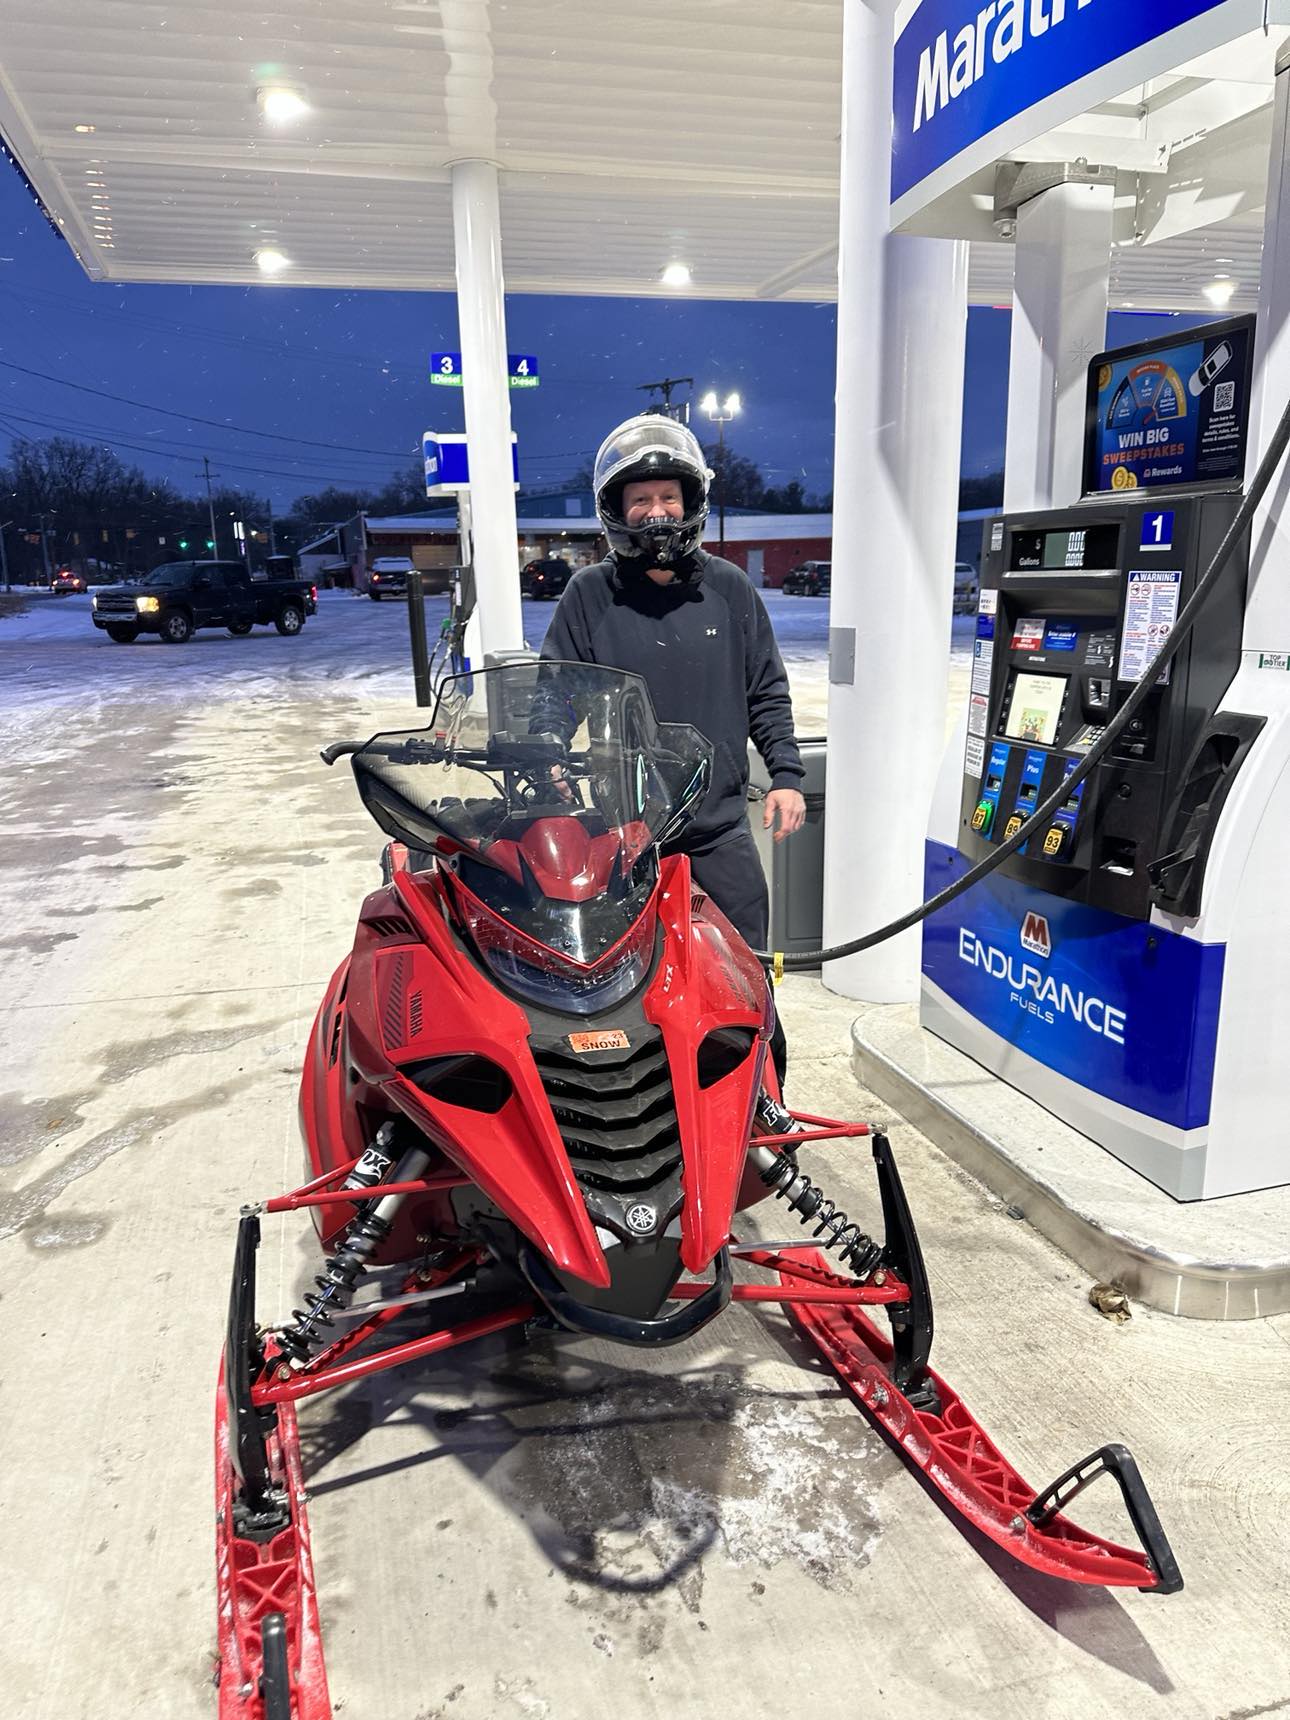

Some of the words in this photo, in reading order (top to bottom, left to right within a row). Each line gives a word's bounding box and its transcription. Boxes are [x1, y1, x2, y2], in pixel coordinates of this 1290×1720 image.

[440, 356, 454, 374] 3
[517, 359, 529, 376] 4
[434, 375, 461, 385] Diesel
[511, 376, 537, 386] Diesel
[1118, 431, 1144, 449] WIN
[1146, 427, 1169, 445] BIG
[1102, 443, 1185, 465] SWEEPSTAKES
[1151, 465, 1182, 477] Rewards
[1152, 514, 1163, 542] 1
[1018, 557, 1040, 566] Gallons
[1140, 573, 1176, 583] WARNING
[1026, 764, 1040, 774] Plus
[973, 812, 985, 824] 87
[1006, 823, 1019, 836] 89
[1046, 835, 1060, 849] 93
[663, 964, 674, 993] LTX
[959, 927, 1127, 1045] ENDURANCE
[409, 989, 423, 1039] YAMAHA
[1010, 991, 1055, 1025] FUELS
[581, 1039, 621, 1050] SNOW
